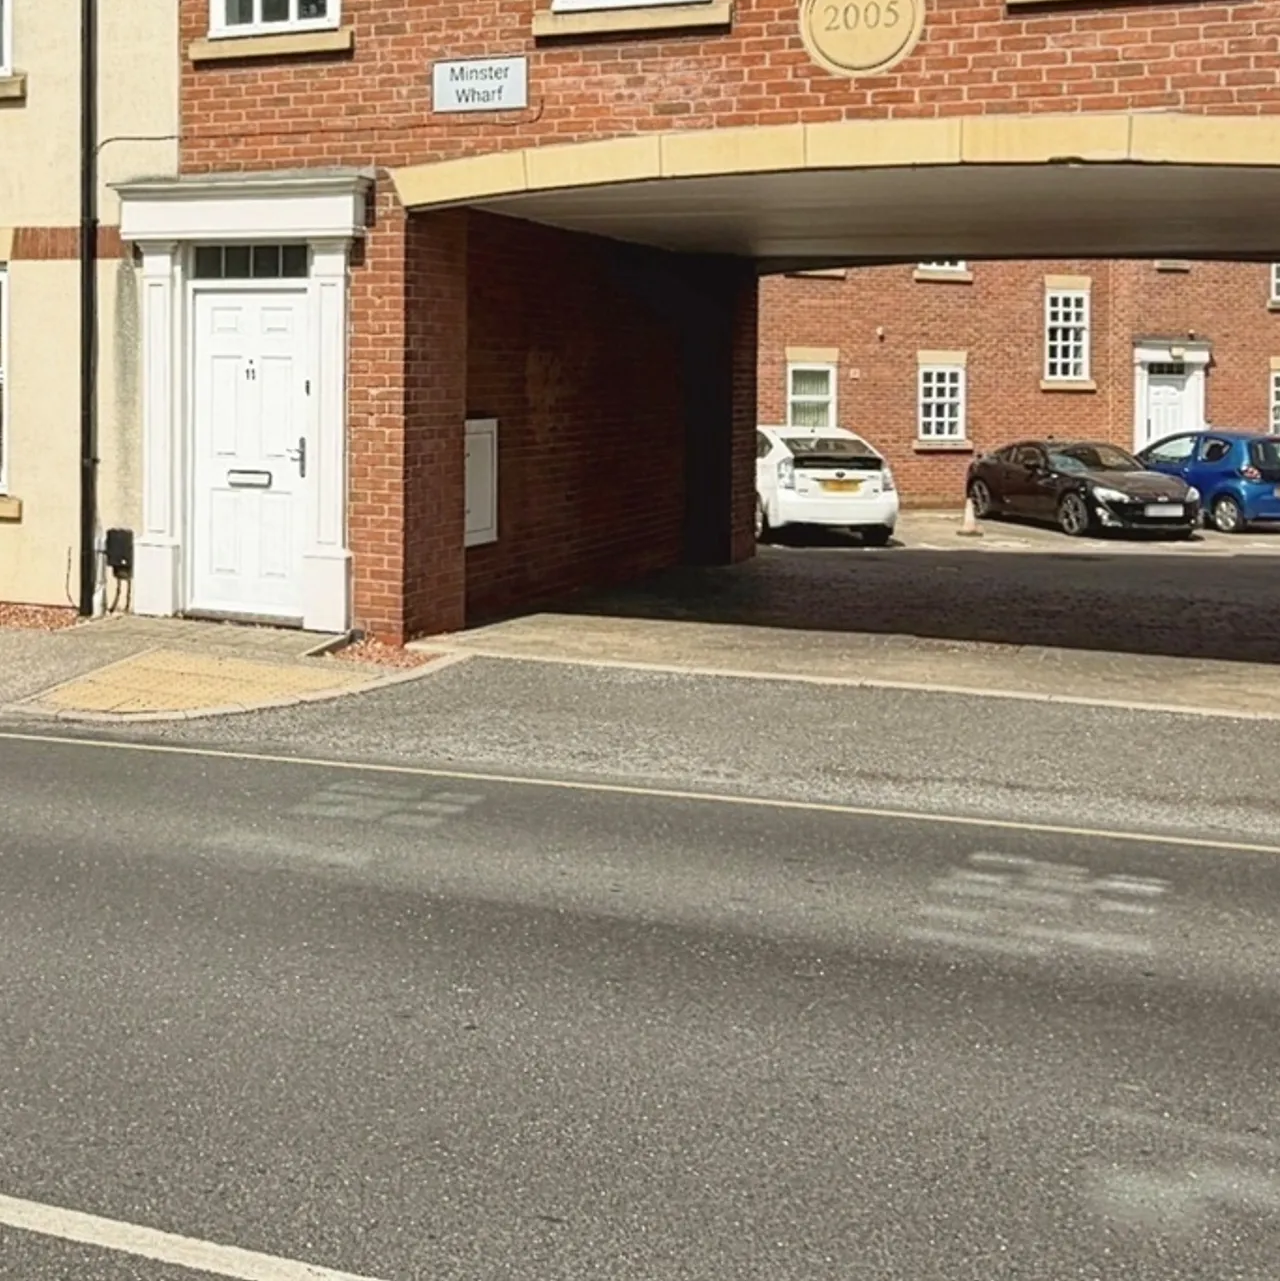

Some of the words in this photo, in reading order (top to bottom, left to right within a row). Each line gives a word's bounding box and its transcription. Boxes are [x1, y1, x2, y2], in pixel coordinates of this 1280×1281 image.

[823, 0, 900, 32] 2005
[449, 66, 510, 82] Minster
[455, 85, 504, 104] Wharf
